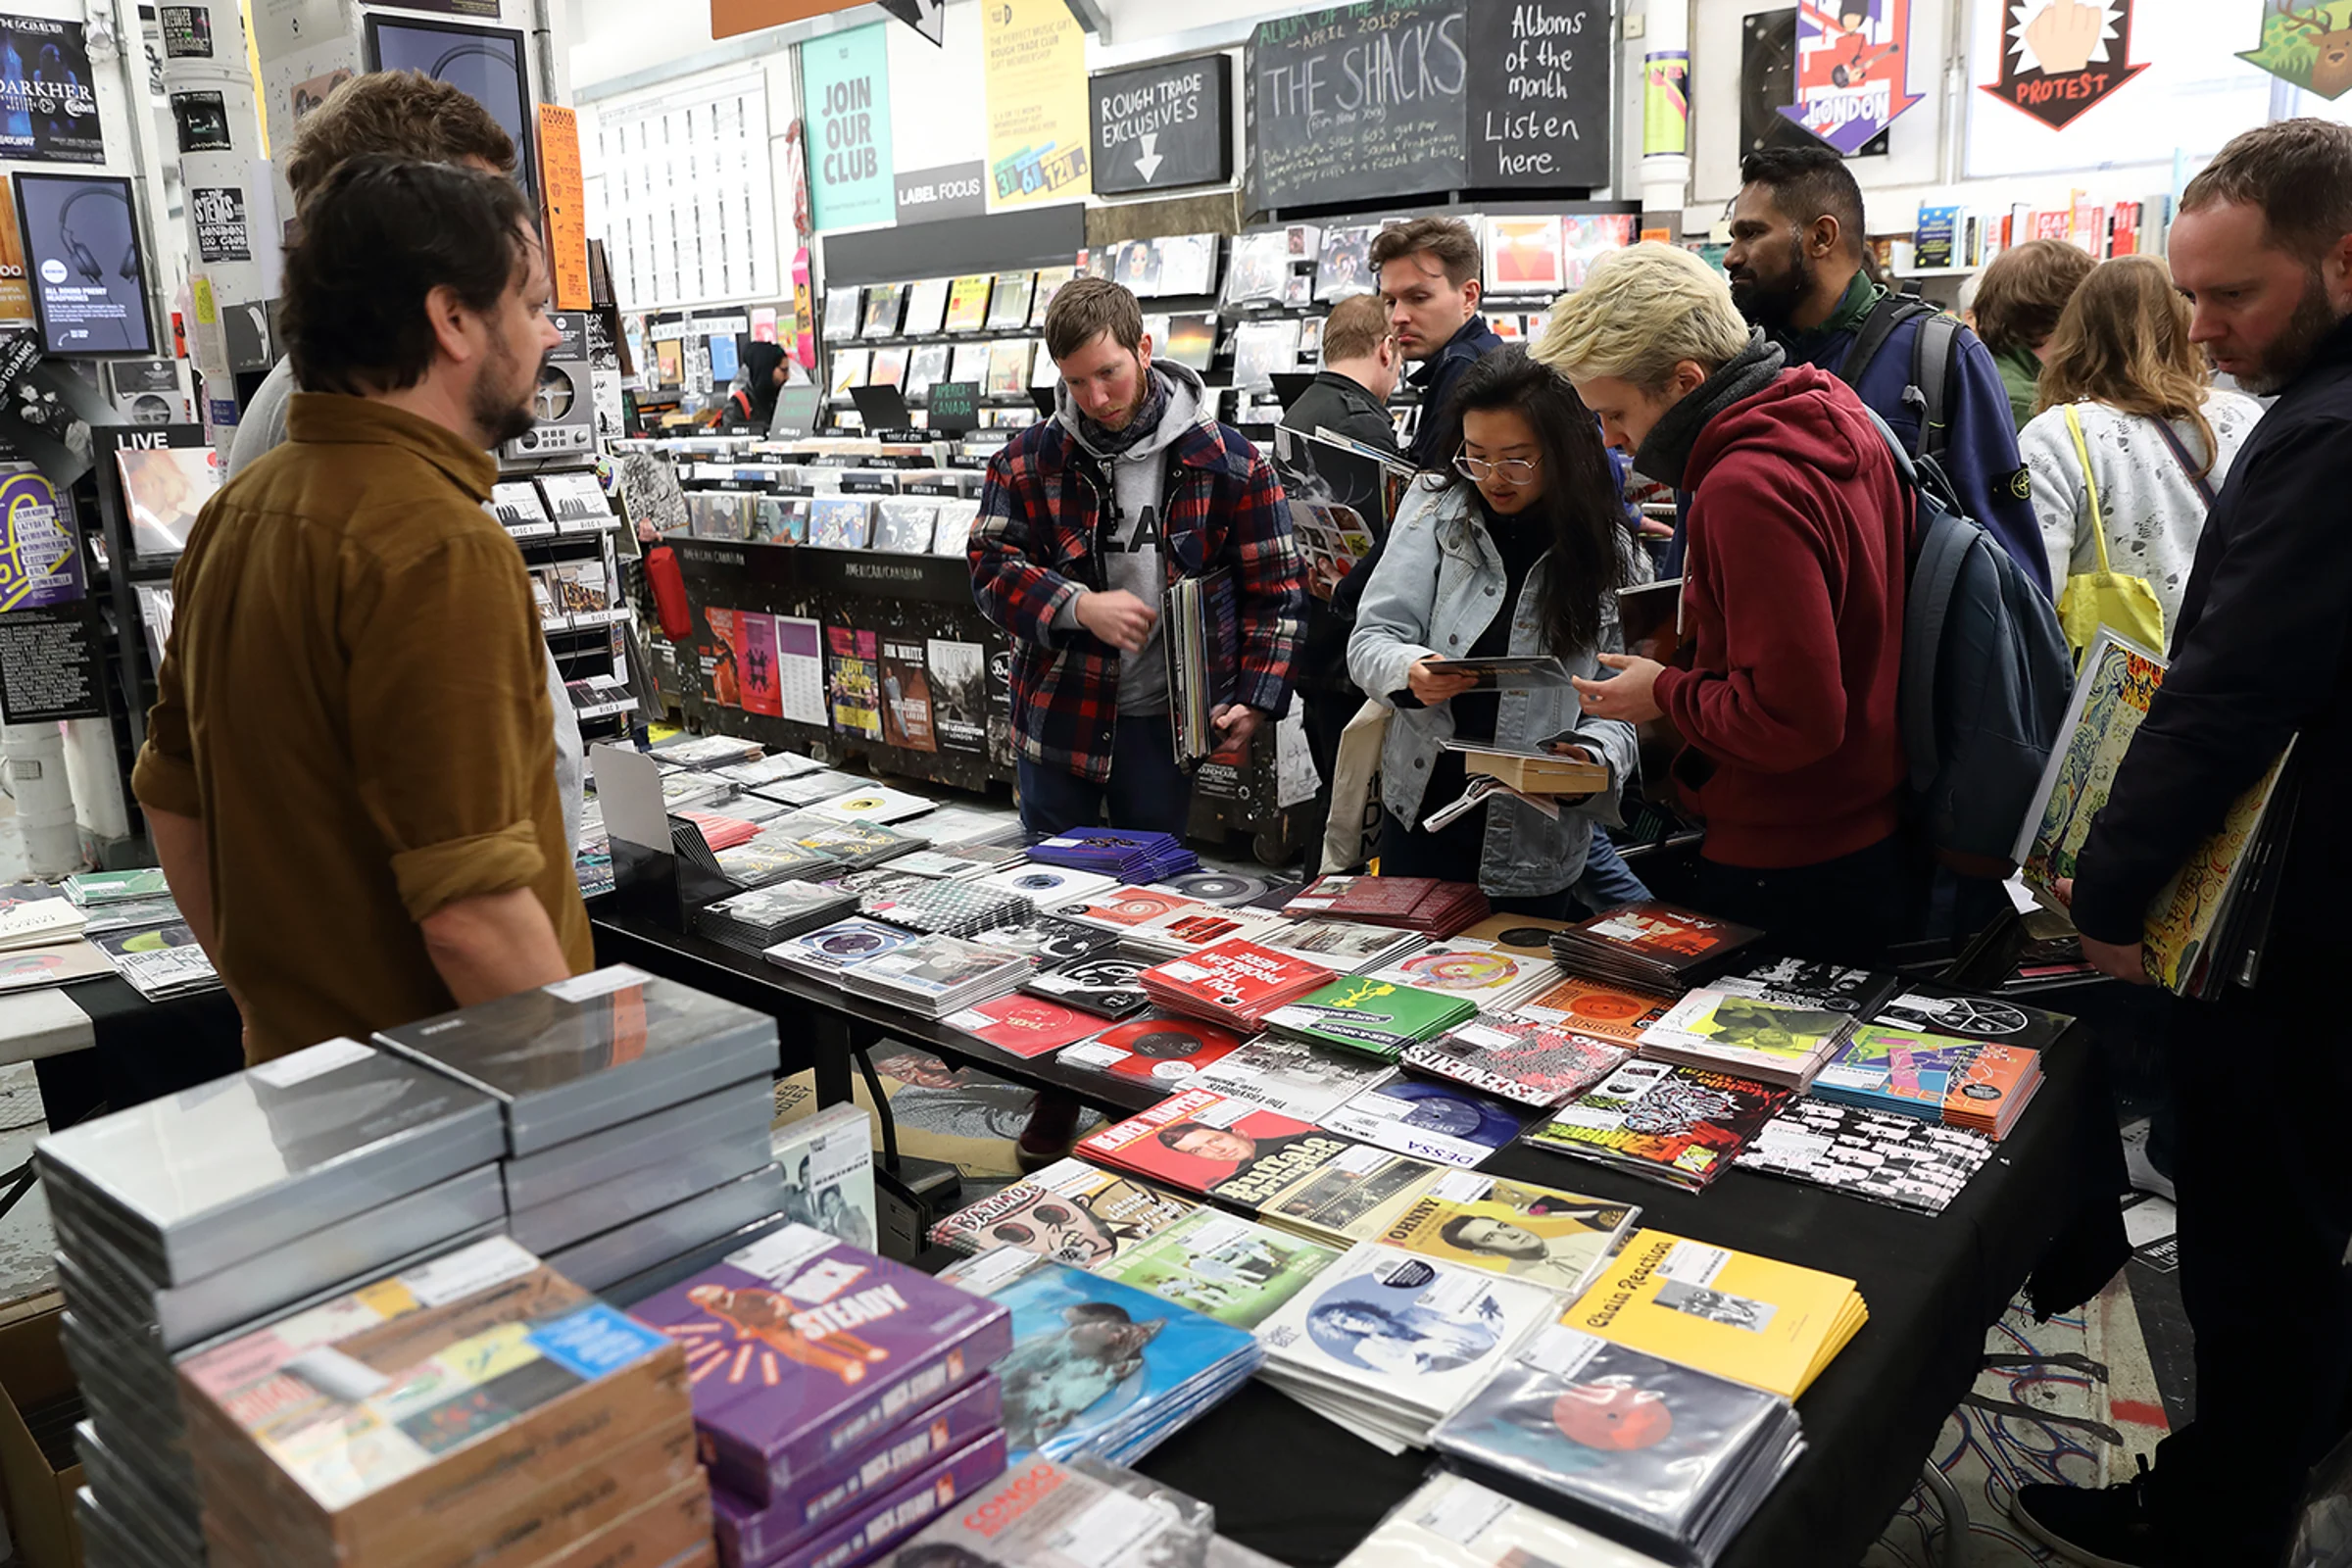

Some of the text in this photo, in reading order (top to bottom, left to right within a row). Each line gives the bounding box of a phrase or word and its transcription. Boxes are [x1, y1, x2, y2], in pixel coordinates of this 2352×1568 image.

[1258, 15, 1311, 47] ALBUM
[1318, 8, 1338, 26] OF
[1302, 11, 1400, 50] APRIL 2018
[1262, 14, 1467, 118] THE SHACKS
[1505, 40, 1572, 73] of the
[821, 75, 872, 118] JOIN
[1102, 74, 1202, 122] ROUGH TRADE
[1508, 71, 1568, 100] month
[2016, 73, 2109, 106] PROTEST
[1102, 96, 1199, 148] EXCLUSIVES
[1808, 92, 1889, 126] LONDON
[825, 113, 873, 151] OUR
[1485, 110, 1580, 141] Listen
[823, 146, 878, 186] CLUB
[1498, 144, 1561, 175] here.
[898, 178, 980, 207] LABEL FOCUS
[194, 195, 234, 223] STEMS
[200, 225, 245, 236] LONDON
[931, 401, 972, 416] CANADA
[118, 432, 169, 450] LIVE
[512, 526, 528, 536] DISC
[580, 520, 596, 530] DISC
[591, 612, 606, 621] DISC
[599, 705, 614, 713] DISC
[1201, 953, 1287, 985] PROBLEM
[1209, 966, 1244, 982] THE
[1235, 953, 1288, 971] HERE
[1202, 978, 1246, 998] YOU
[1405, 1046, 1554, 1108] DESCENDENTS
[1205, 1082, 1288, 1110] The Easybeats
[1405, 1117, 1455, 1134] DESSA
[1215, 1137, 1327, 1195] Buffalo
[1407, 1140, 1474, 1165] DESSA
[1238, 1141, 1348, 1202] Springfield
[1382, 1198, 1441, 1248] JOHNNY
[1586, 1241, 1674, 1328] Chain Reaction
[787, 1282, 909, 1341] STEADY
[961, 1463, 1055, 1531] CONGO
